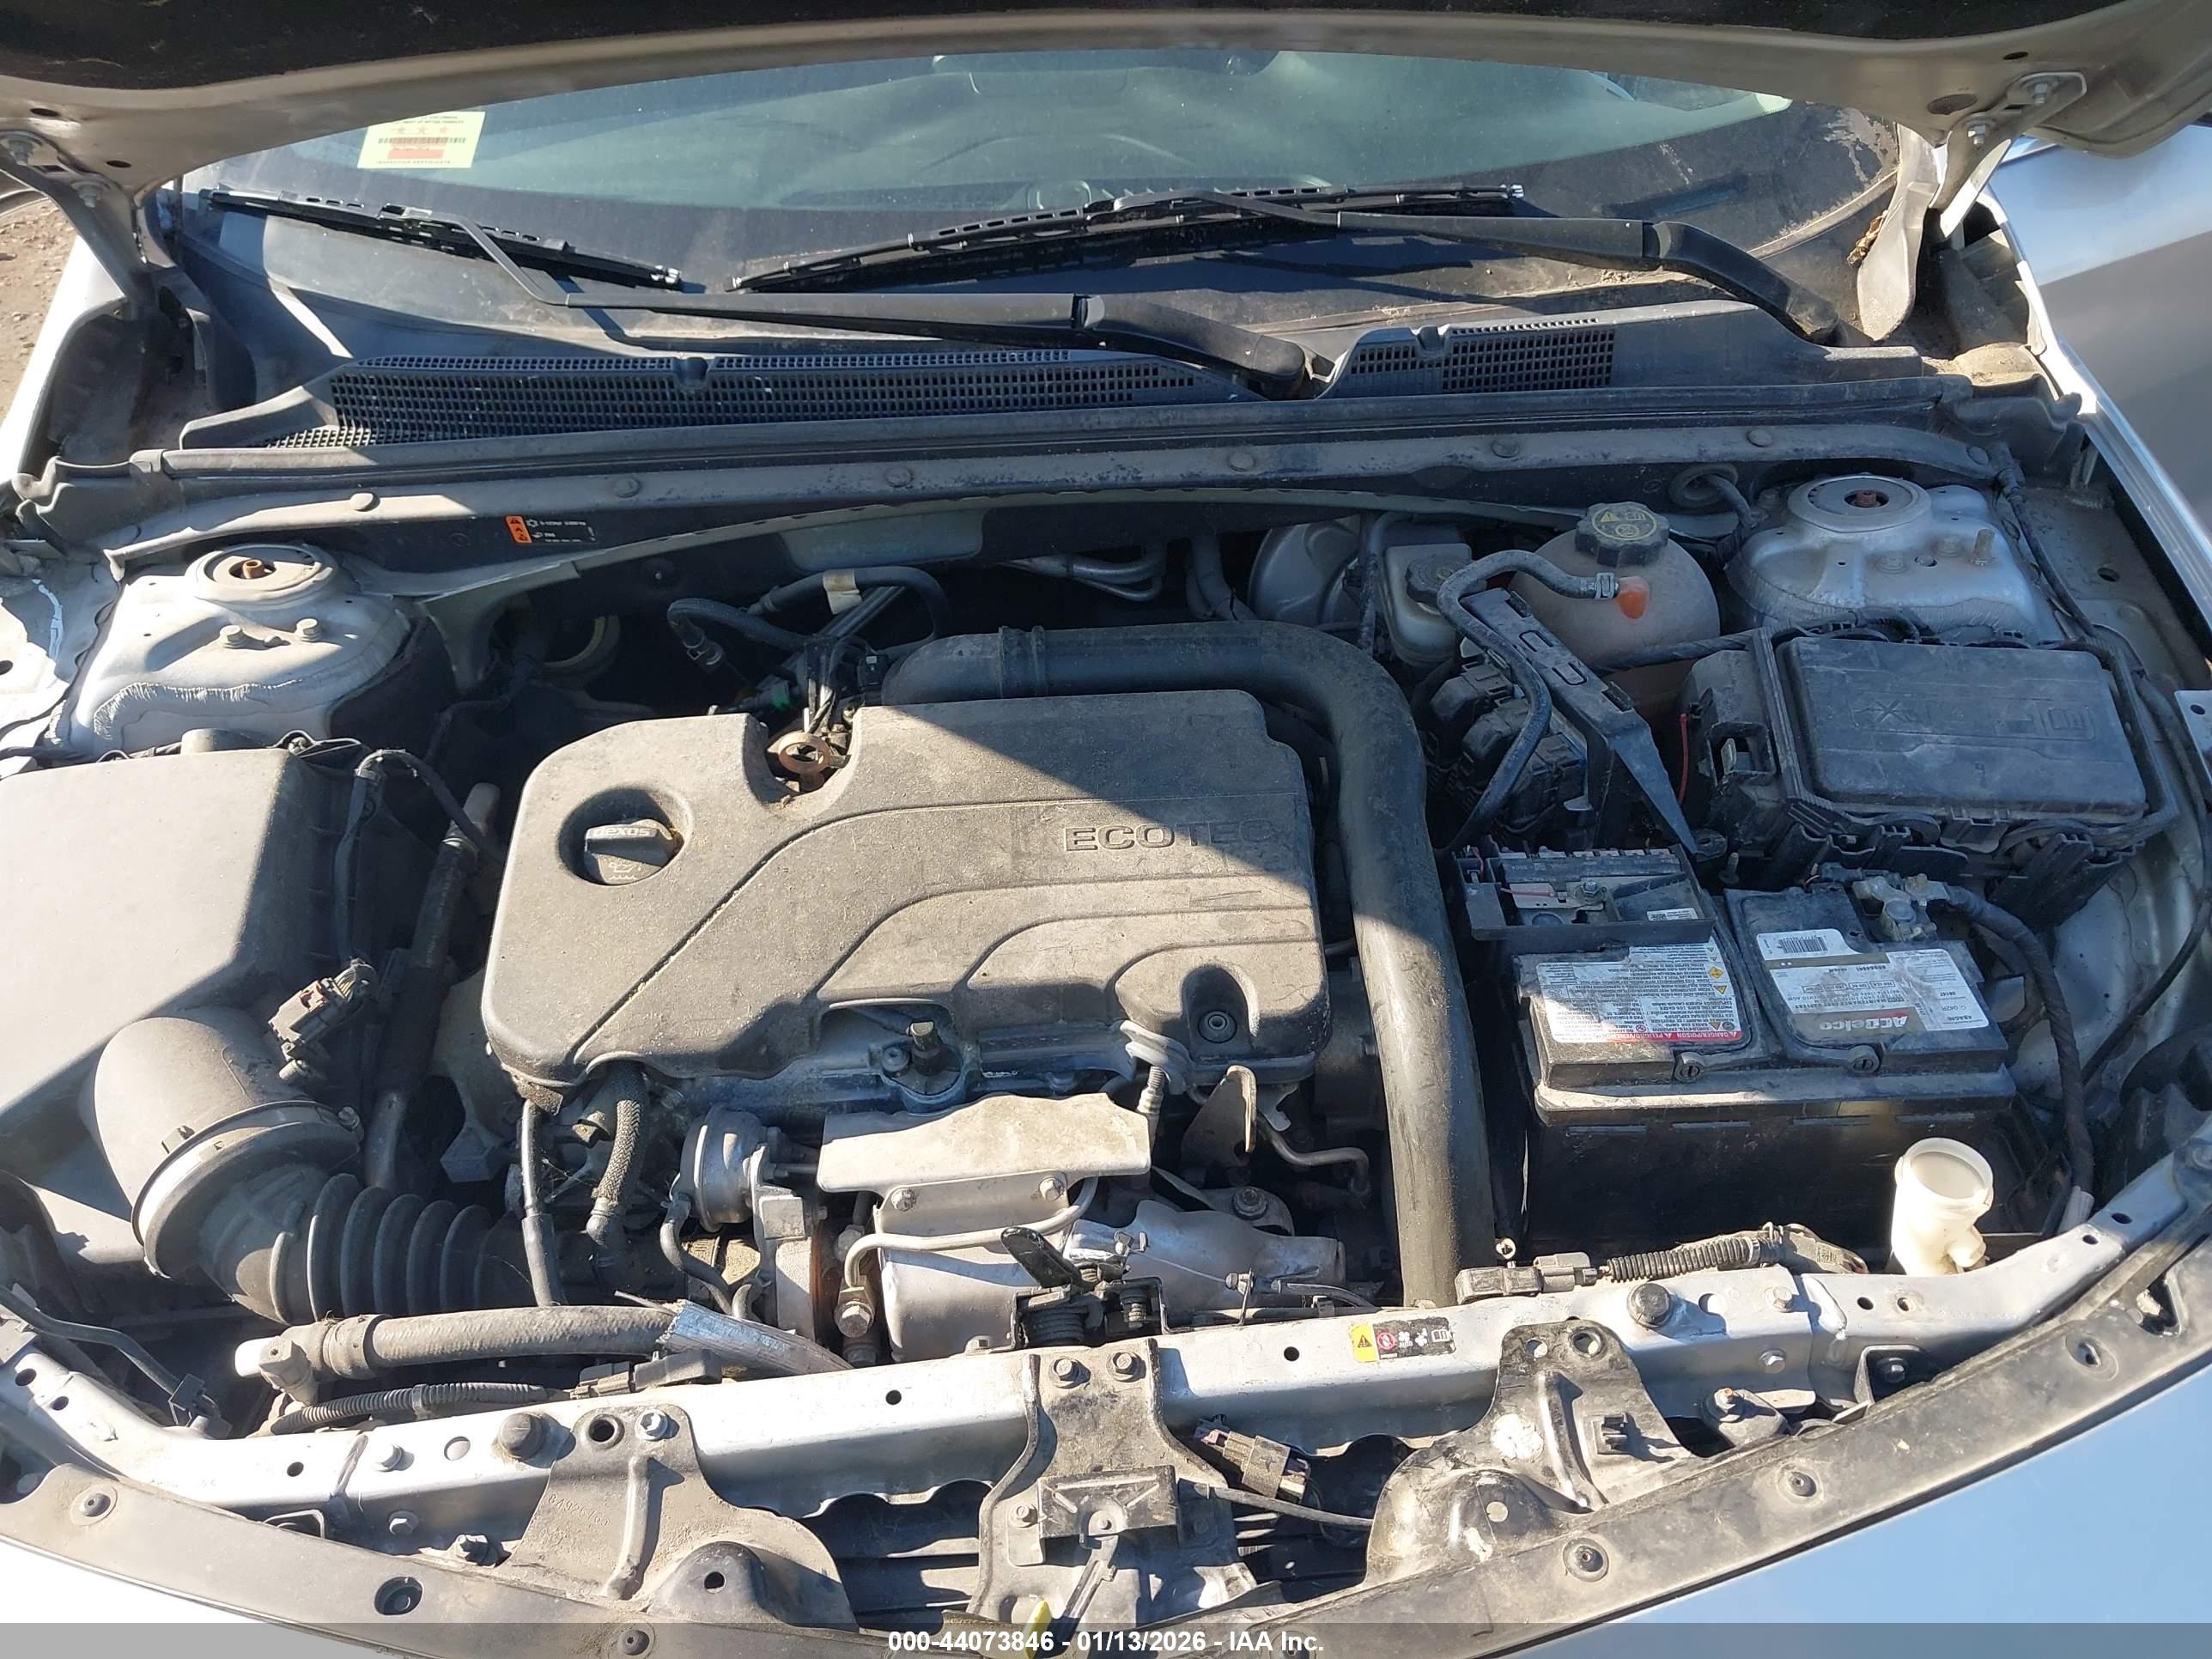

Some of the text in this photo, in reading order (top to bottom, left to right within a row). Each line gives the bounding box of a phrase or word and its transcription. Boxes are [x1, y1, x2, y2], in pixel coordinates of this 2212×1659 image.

[592, 825, 650, 836] dexos
[1064, 819, 1273, 851] ECOTEC
[1820, 1016, 1908, 1031] ACDelco
